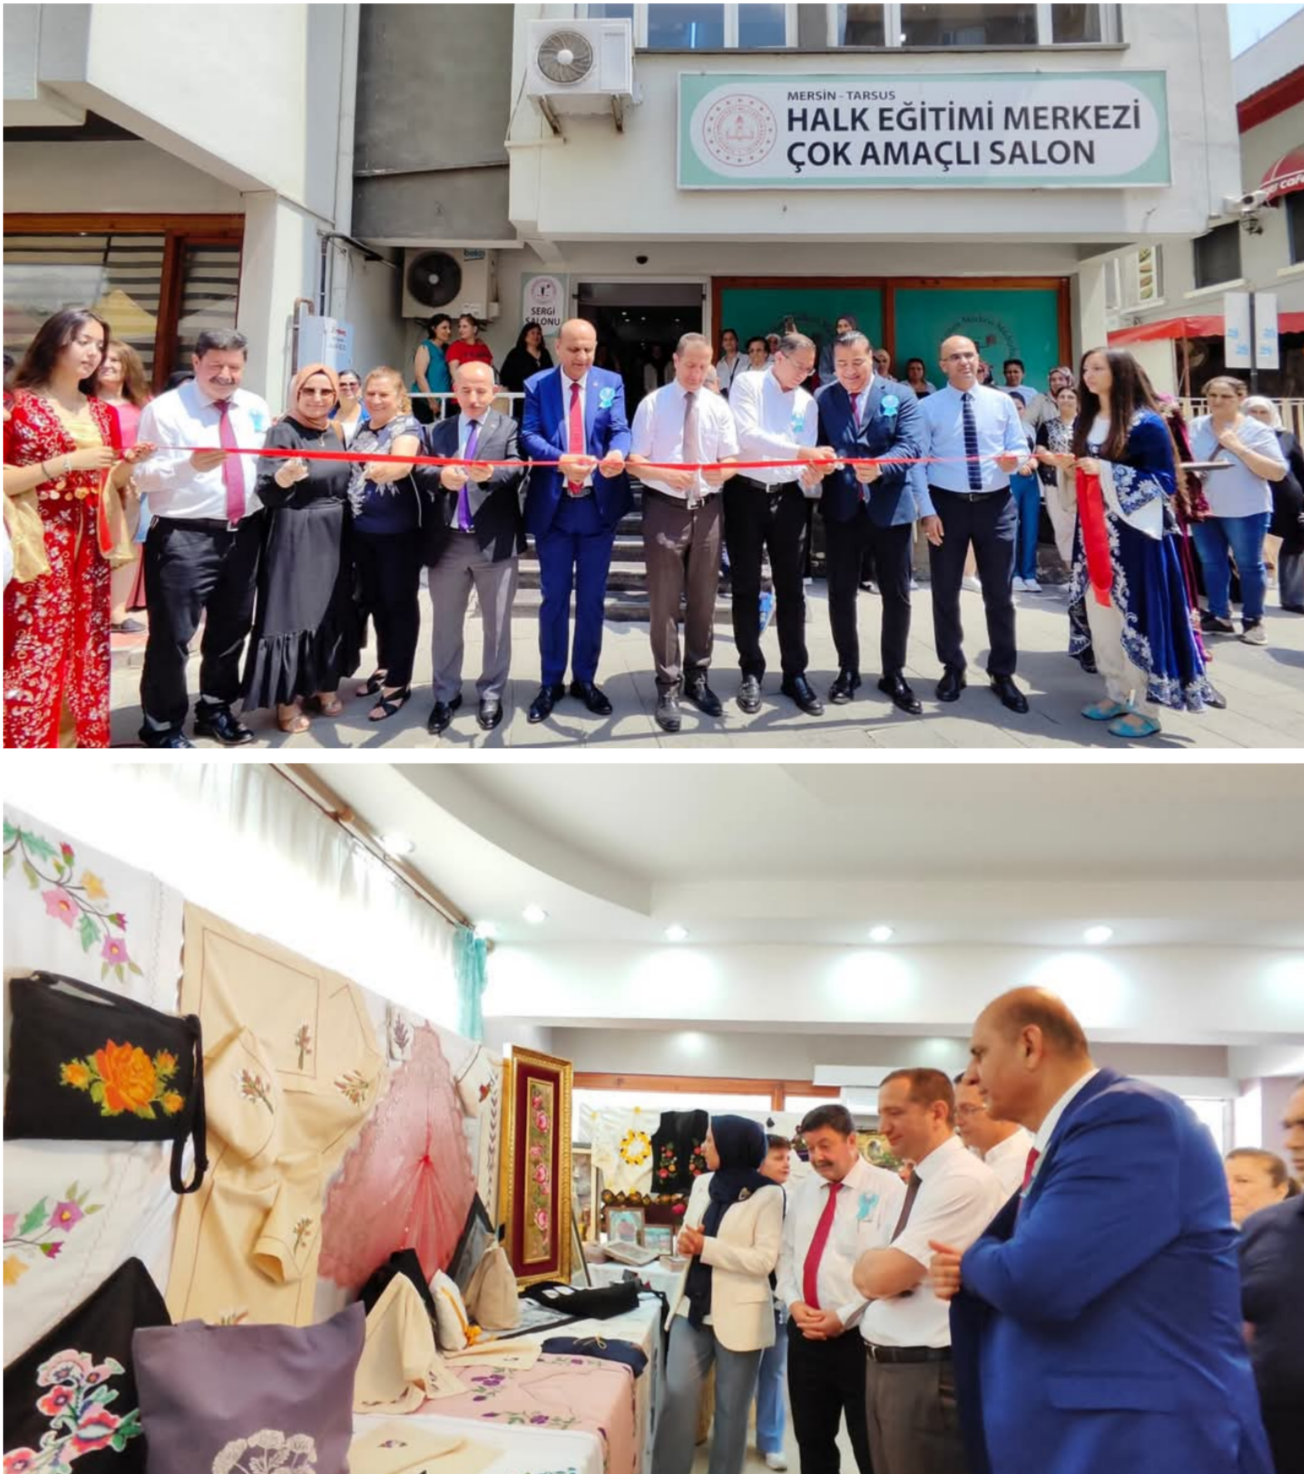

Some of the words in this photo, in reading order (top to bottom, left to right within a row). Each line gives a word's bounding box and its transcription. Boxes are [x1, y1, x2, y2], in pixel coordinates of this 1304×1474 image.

[787, 89, 836, 101] MERSİN
[846, 90, 896, 101] TARSUS
[787, 107, 870, 132] HALK
[878, 100, 994, 132] EĞİTİMİ
[1003, 98, 1141, 131] MERKEZİ
[786, 141, 852, 173] ÇOK
[860, 140, 980, 172] AMAÇLI
[989, 140, 1095, 166] SALON
